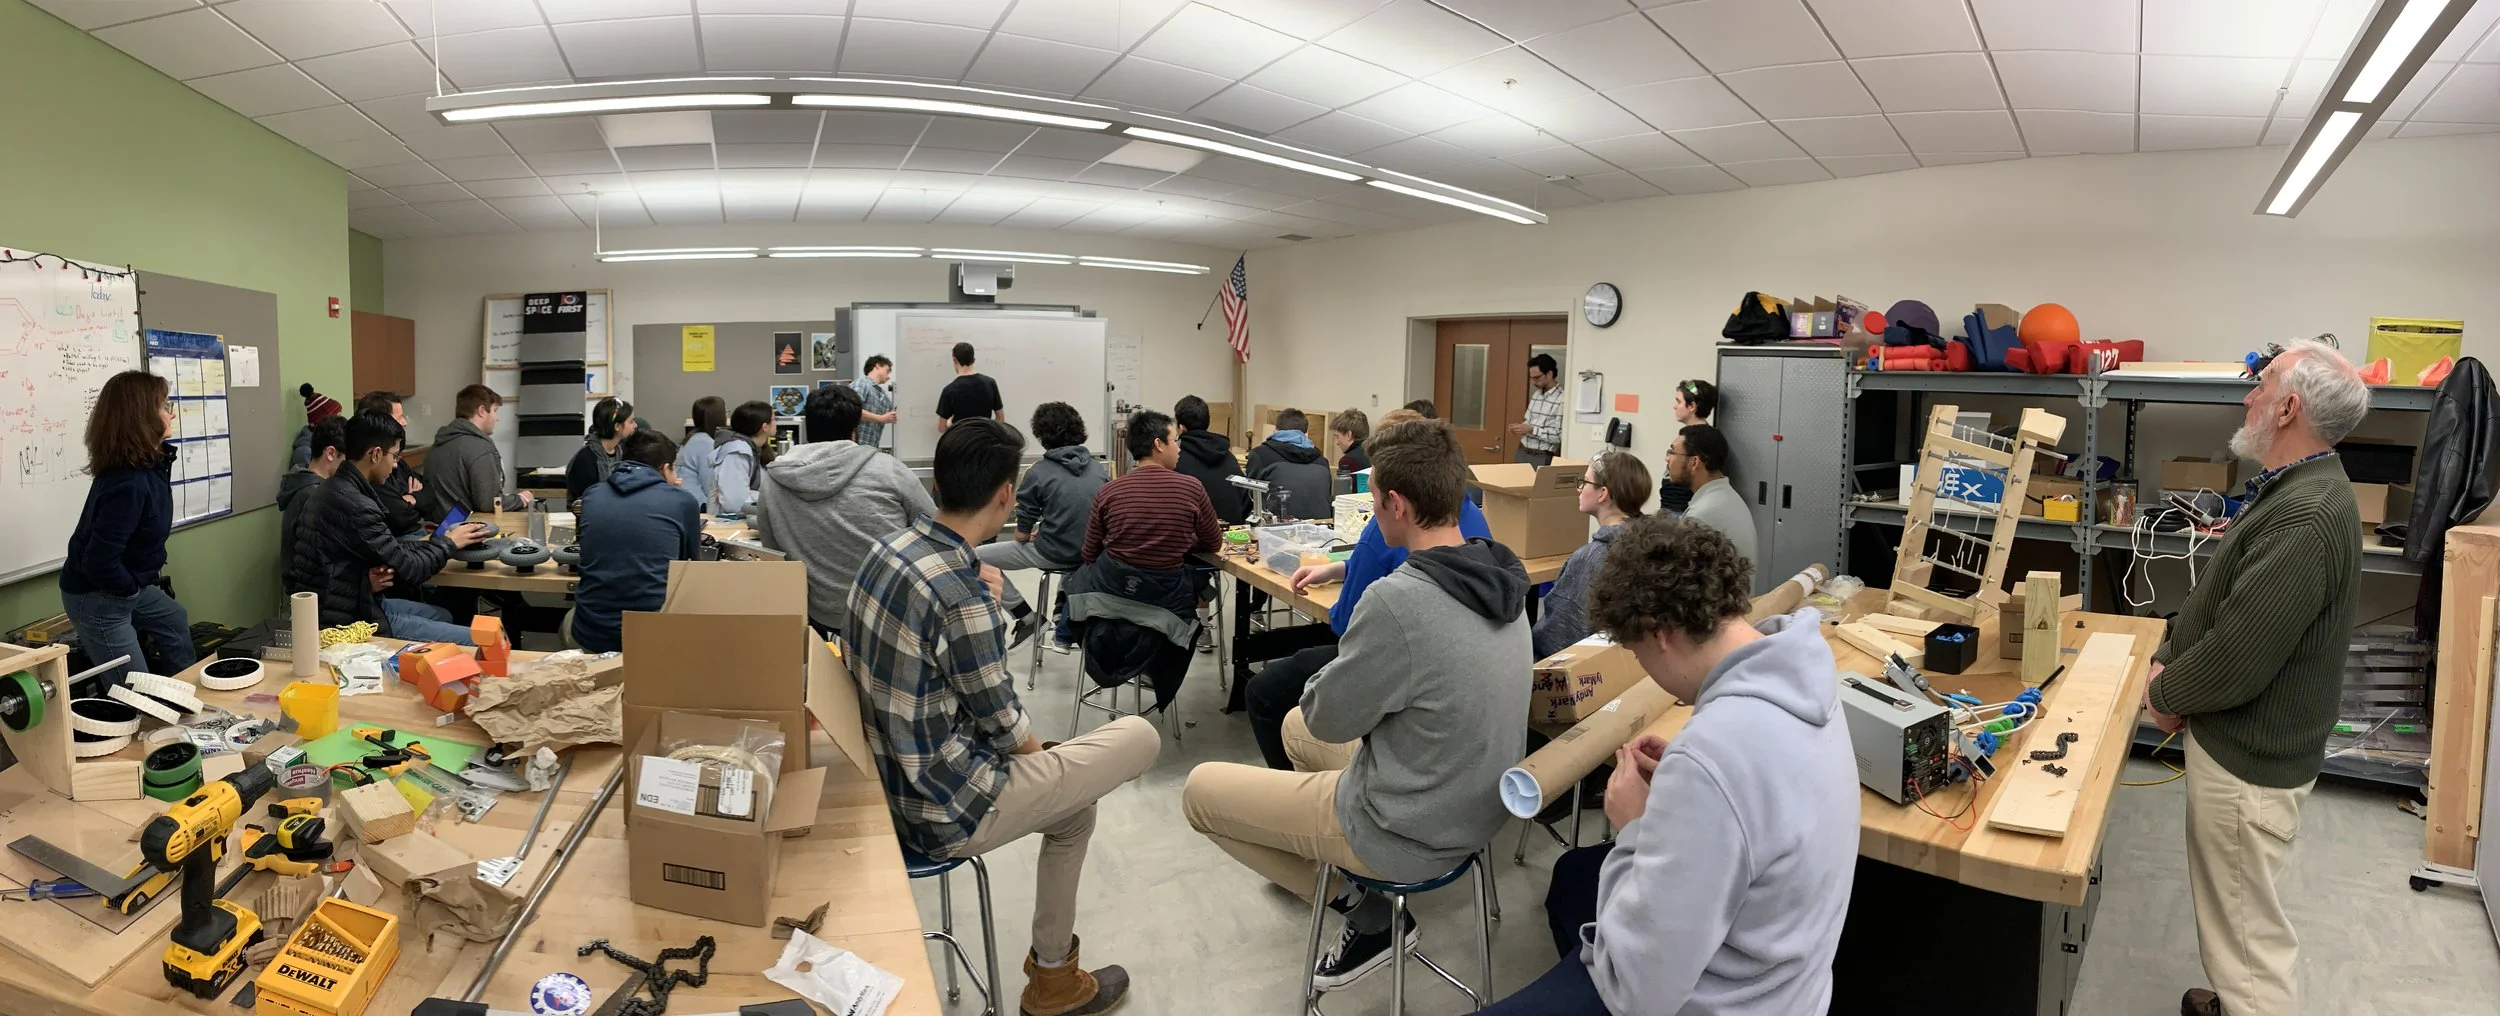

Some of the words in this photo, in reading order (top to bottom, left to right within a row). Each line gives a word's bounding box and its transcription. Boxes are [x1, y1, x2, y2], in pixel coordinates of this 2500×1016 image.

[88, 282, 111, 301] Today
[557, 304, 583, 314] FIRST
[292, 768, 317, 776] Nashua
[640, 792, 660, 804] EDN
